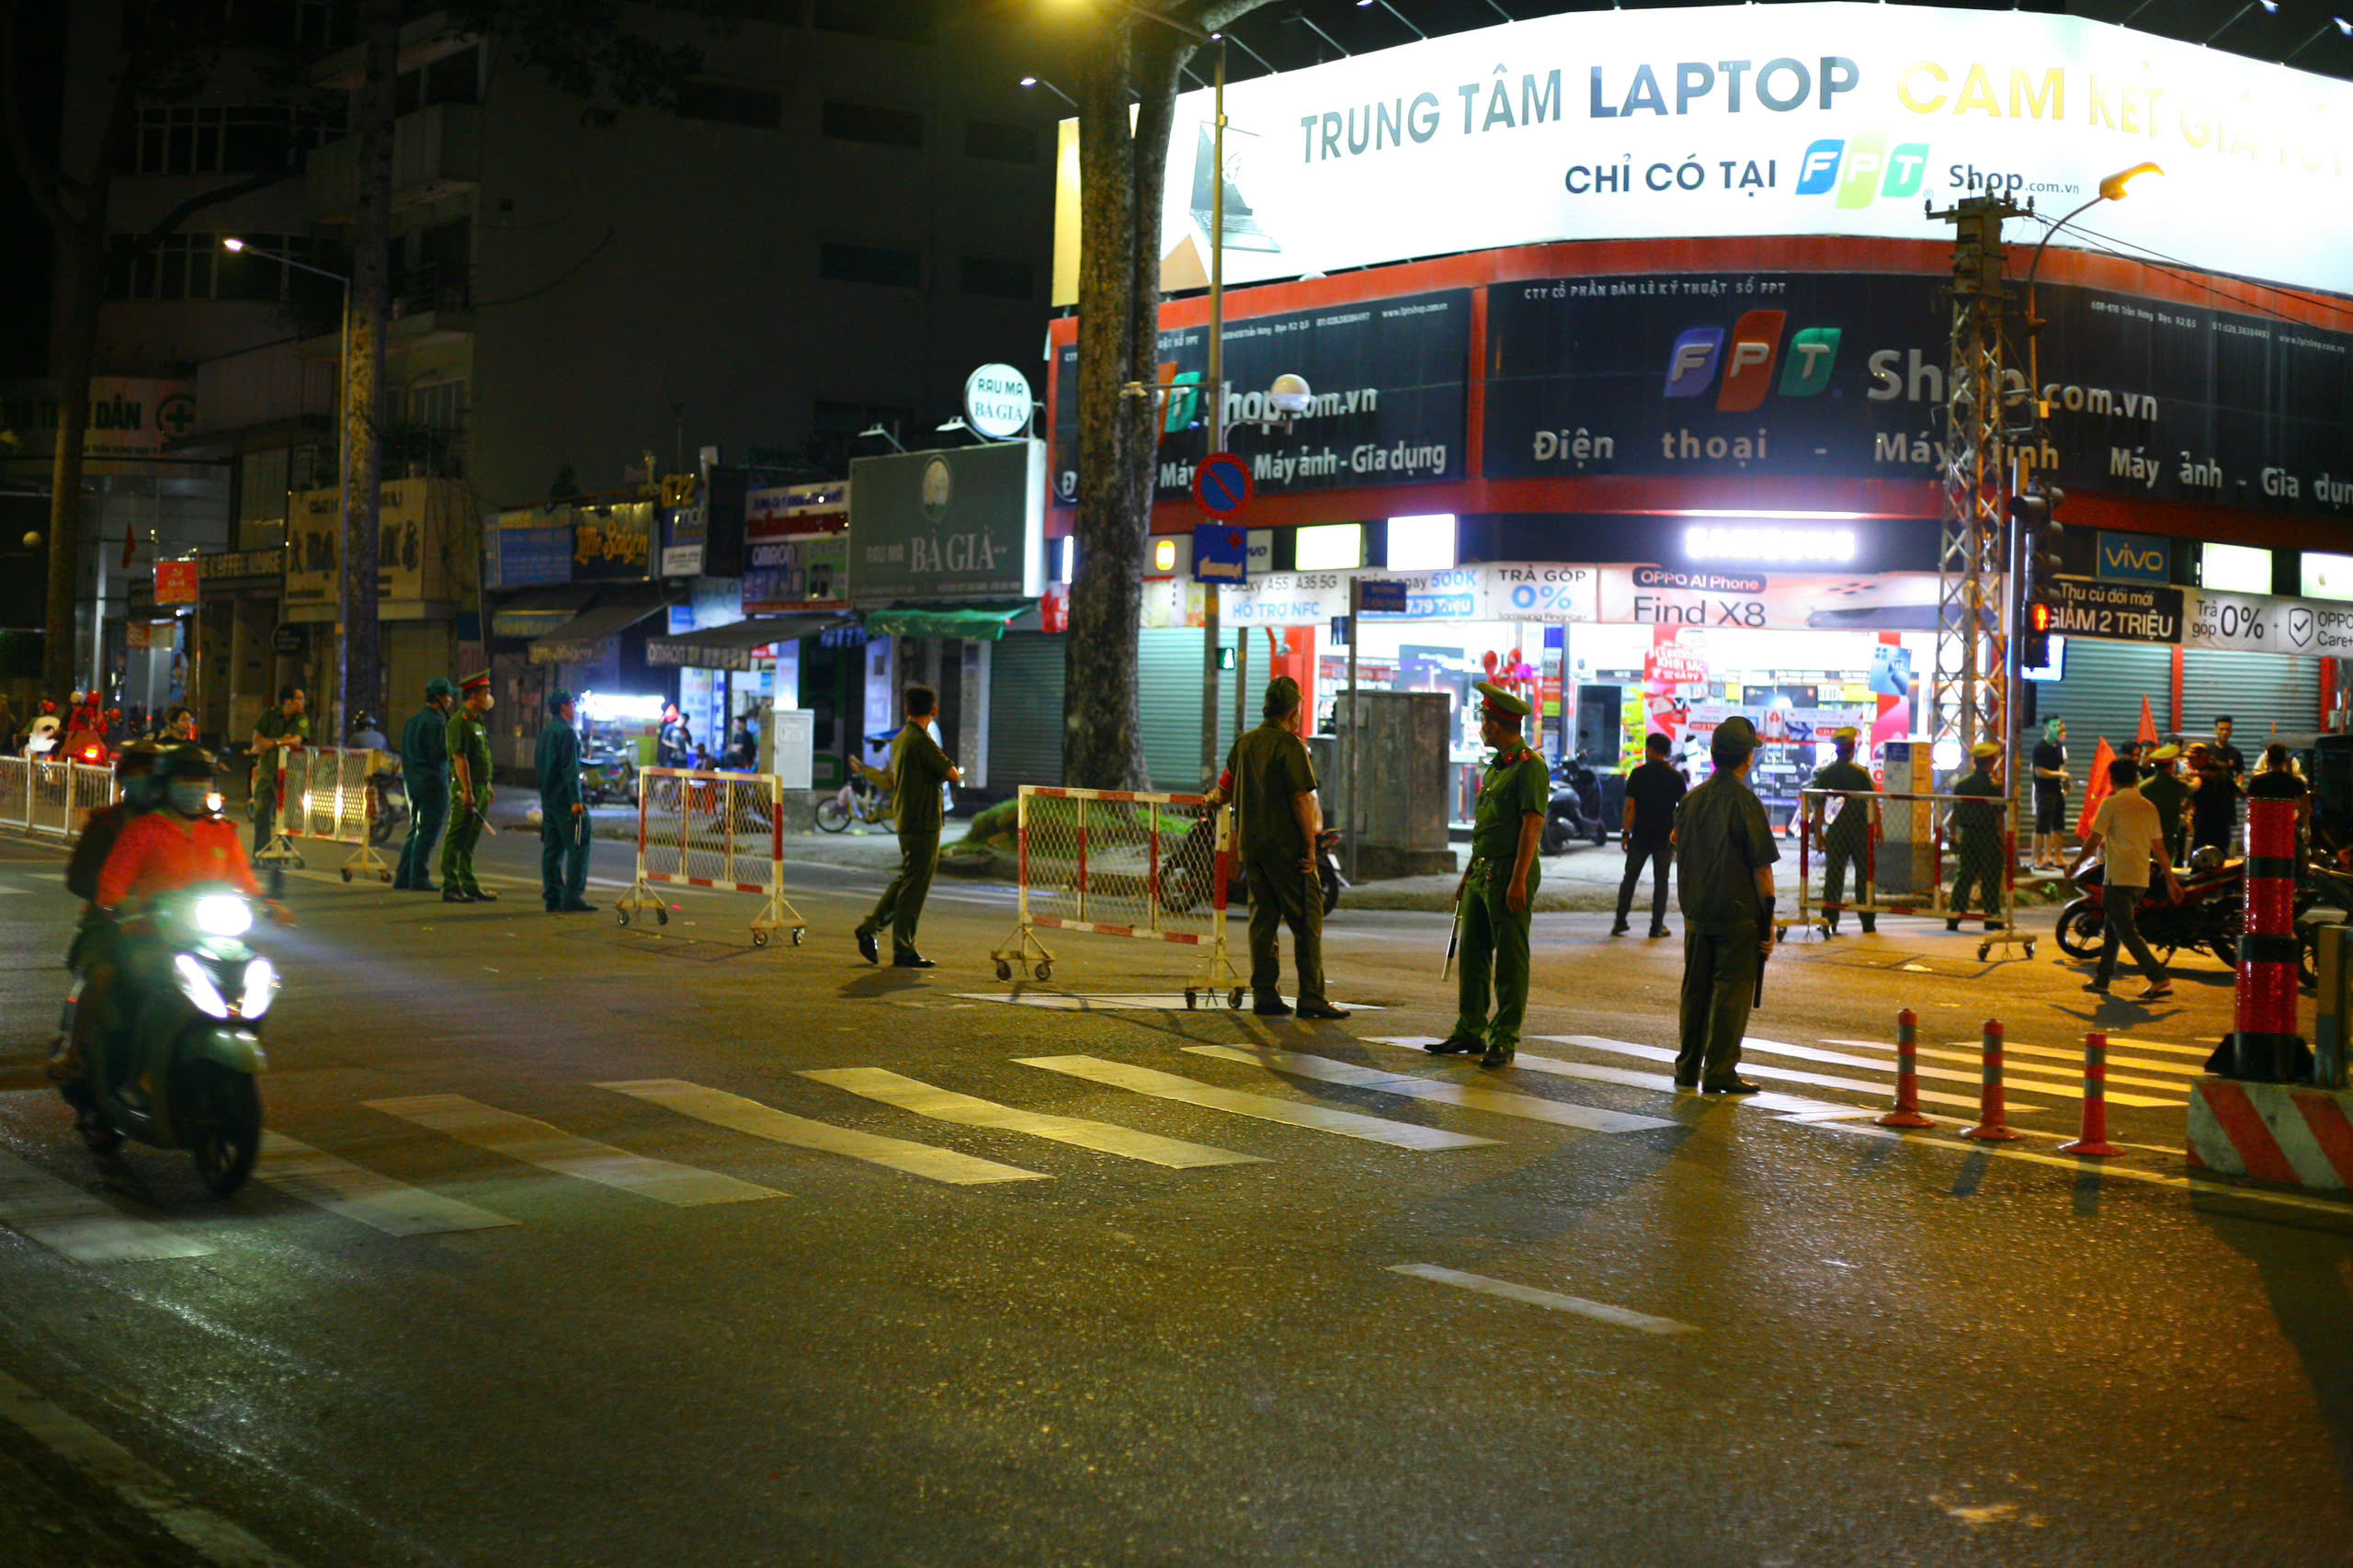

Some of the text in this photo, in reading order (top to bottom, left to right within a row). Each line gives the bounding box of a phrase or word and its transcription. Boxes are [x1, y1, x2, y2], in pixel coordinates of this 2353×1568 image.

[1301, 92, 1440, 164] TRUNG
[1459, 62, 1563, 135] TÂM
[1589, 56, 1860, 119] LAPTOP
[1896, 60, 2065, 120] CAM
[1565, 153, 1631, 194] CHỈ
[1645, 153, 1705, 191] CÓ
[1720, 160, 1776, 197] TẠI
[1524, 287, 1548, 300] CTY
[1760, 282, 1786, 295] FPT
[978, 378, 1002, 394] RAU
[1254, 449, 1297, 483] Máy
[1299, 445, 1336, 477] ảnh
[1390, 440, 1448, 476] dụng
[1533, 428, 1614, 468] Điện
[1662, 428, 1767, 468] thoại
[1874, 431, 1953, 472] Máy
[2110, 446, 2160, 489] Máy
[2179, 449, 2223, 490] ảnh
[910, 525, 995, 574] BÀ GIÀ
[1267, 576, 1289, 591] A55
[1296, 574, 1317, 590] A35
[1319, 574, 1338, 589] 5G
[1432, 569, 1477, 588] 500K
[1499, 564, 1587, 583] TRẢ GÓP
[1640, 570, 1759, 591] OPPO AI Phone
[1511, 585, 1572, 609] 0%
[2060, 582, 2086, 599] Thu
[2088, 586, 2105, 602] cũ
[2130, 590, 2155, 607] mới
[1291, 600, 1322, 619] NFC
[1406, 598, 1434, 615] 7.79
[1633, 596, 1767, 627] Find X8
[2098, 609, 2113, 633] 2
[2116, 608, 2174, 641] TRIỆU
[2192, 620, 2217, 639] góp
[2197, 599, 2264, 640] Trả 0%
[2317, 610, 2353, 630] OPPO
[2317, 631, 2353, 648] Care+
